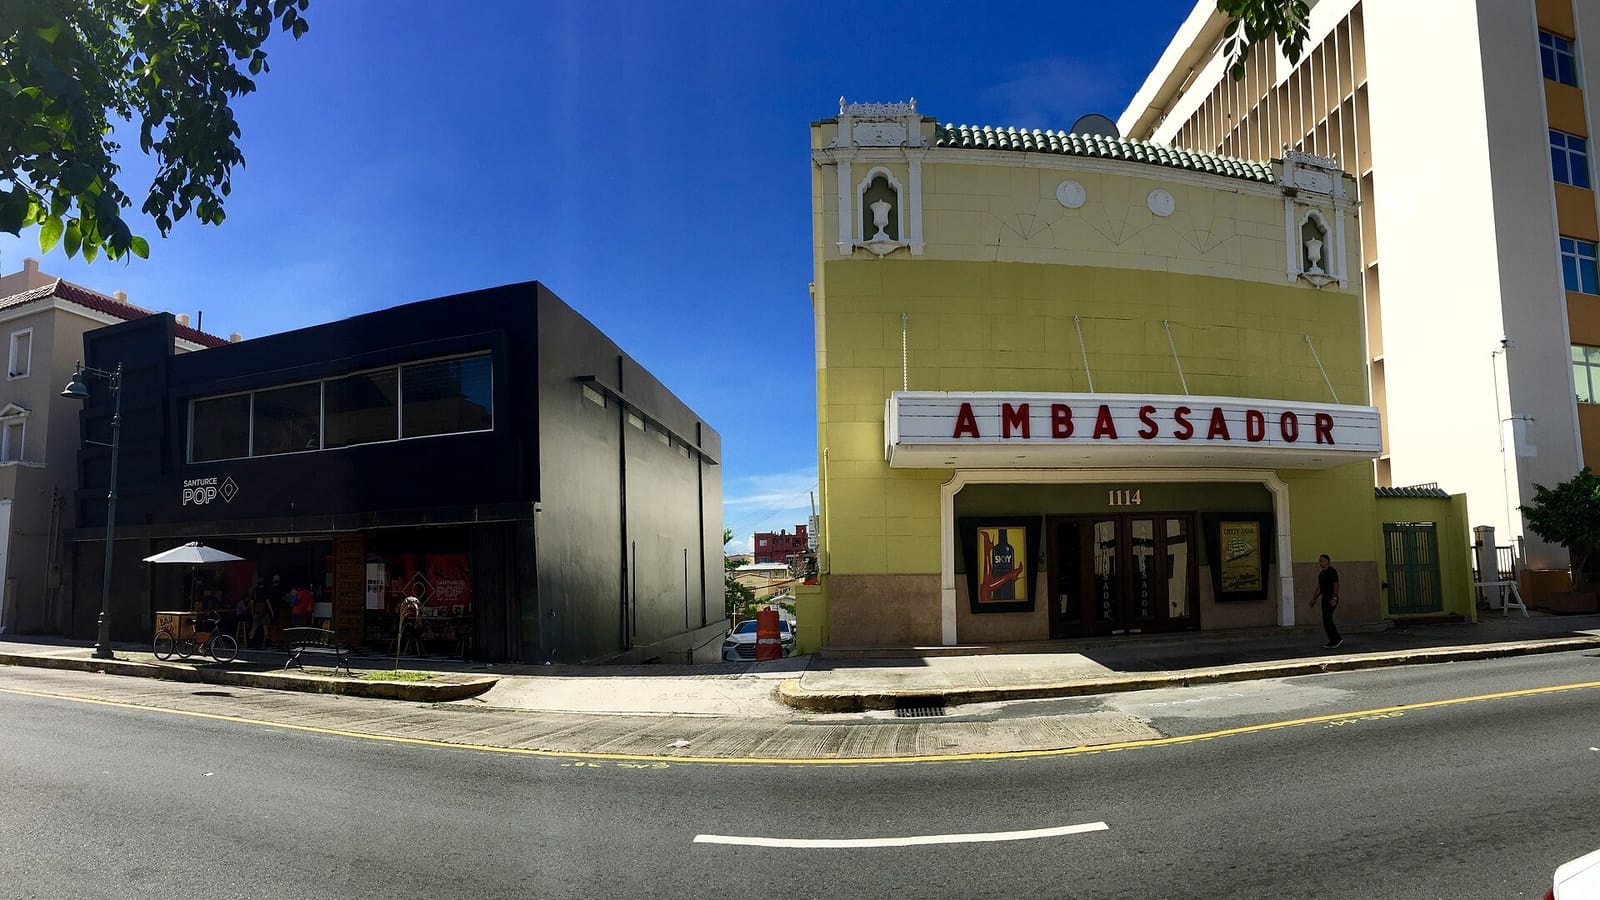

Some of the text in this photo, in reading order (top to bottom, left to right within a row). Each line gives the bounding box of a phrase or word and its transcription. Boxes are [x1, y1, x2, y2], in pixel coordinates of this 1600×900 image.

[952, 402, 1335, 445] AMBASSADOR
[183, 477, 218, 488] SANTURCE
[182, 486, 218, 506] POP
[1107, 489, 1142, 506] 1114
[994, 555, 1012, 564] SKYY
